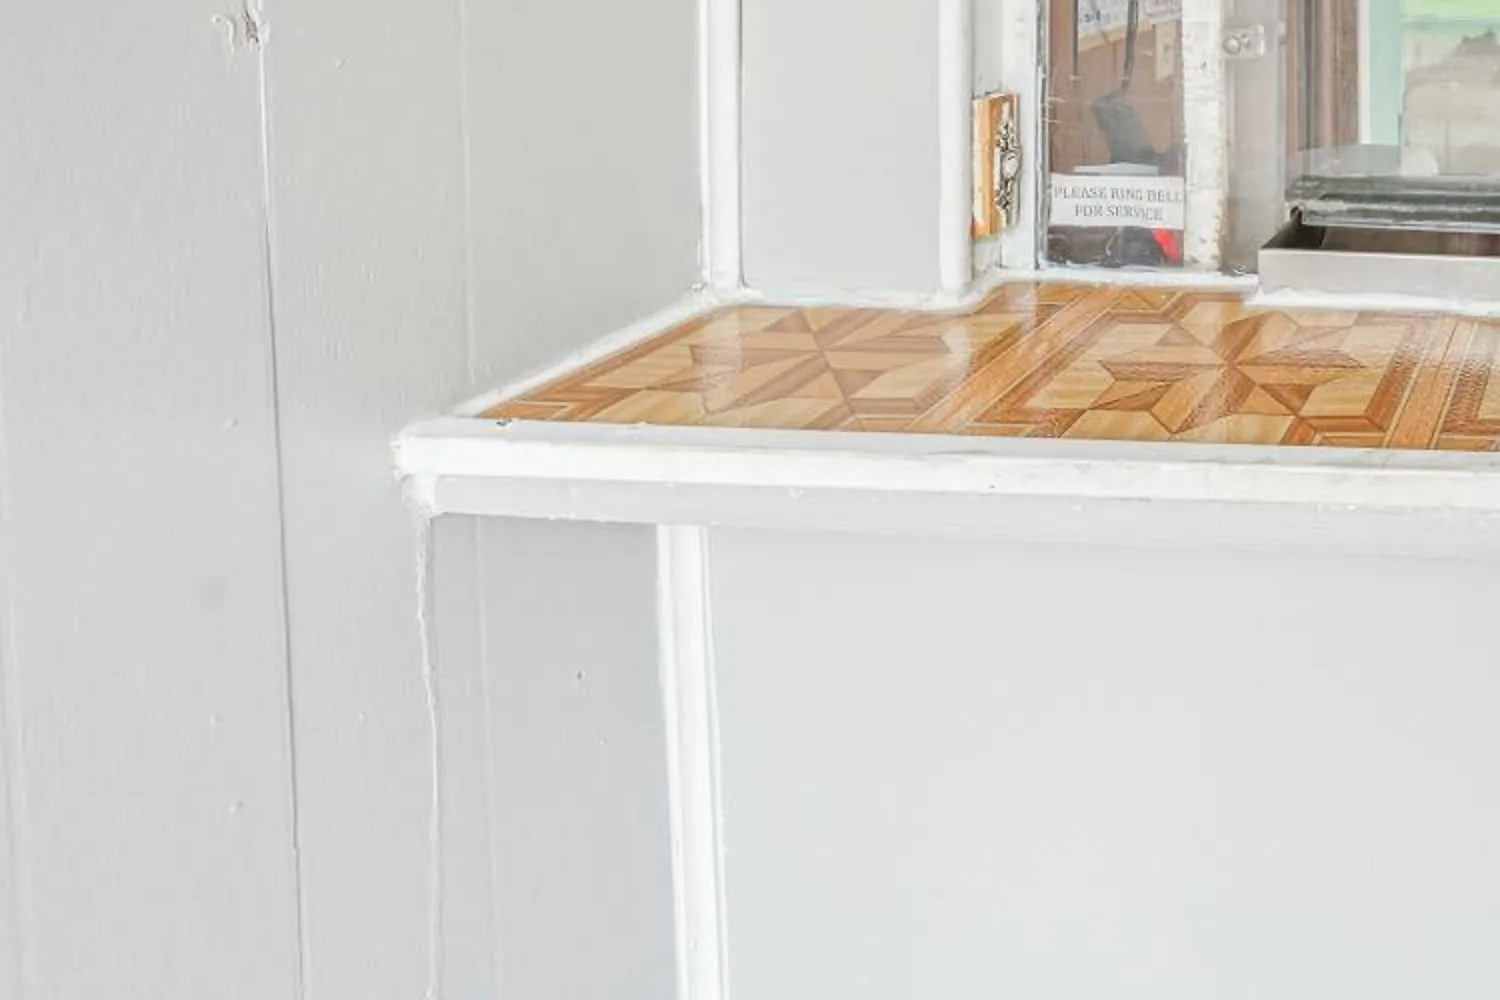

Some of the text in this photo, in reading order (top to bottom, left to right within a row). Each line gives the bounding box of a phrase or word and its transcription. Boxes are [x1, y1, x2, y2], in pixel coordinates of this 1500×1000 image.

[1055, 185, 1183, 203] PLEASE RING BELL
[1075, 204, 1163, 220] FOR SERVICE
